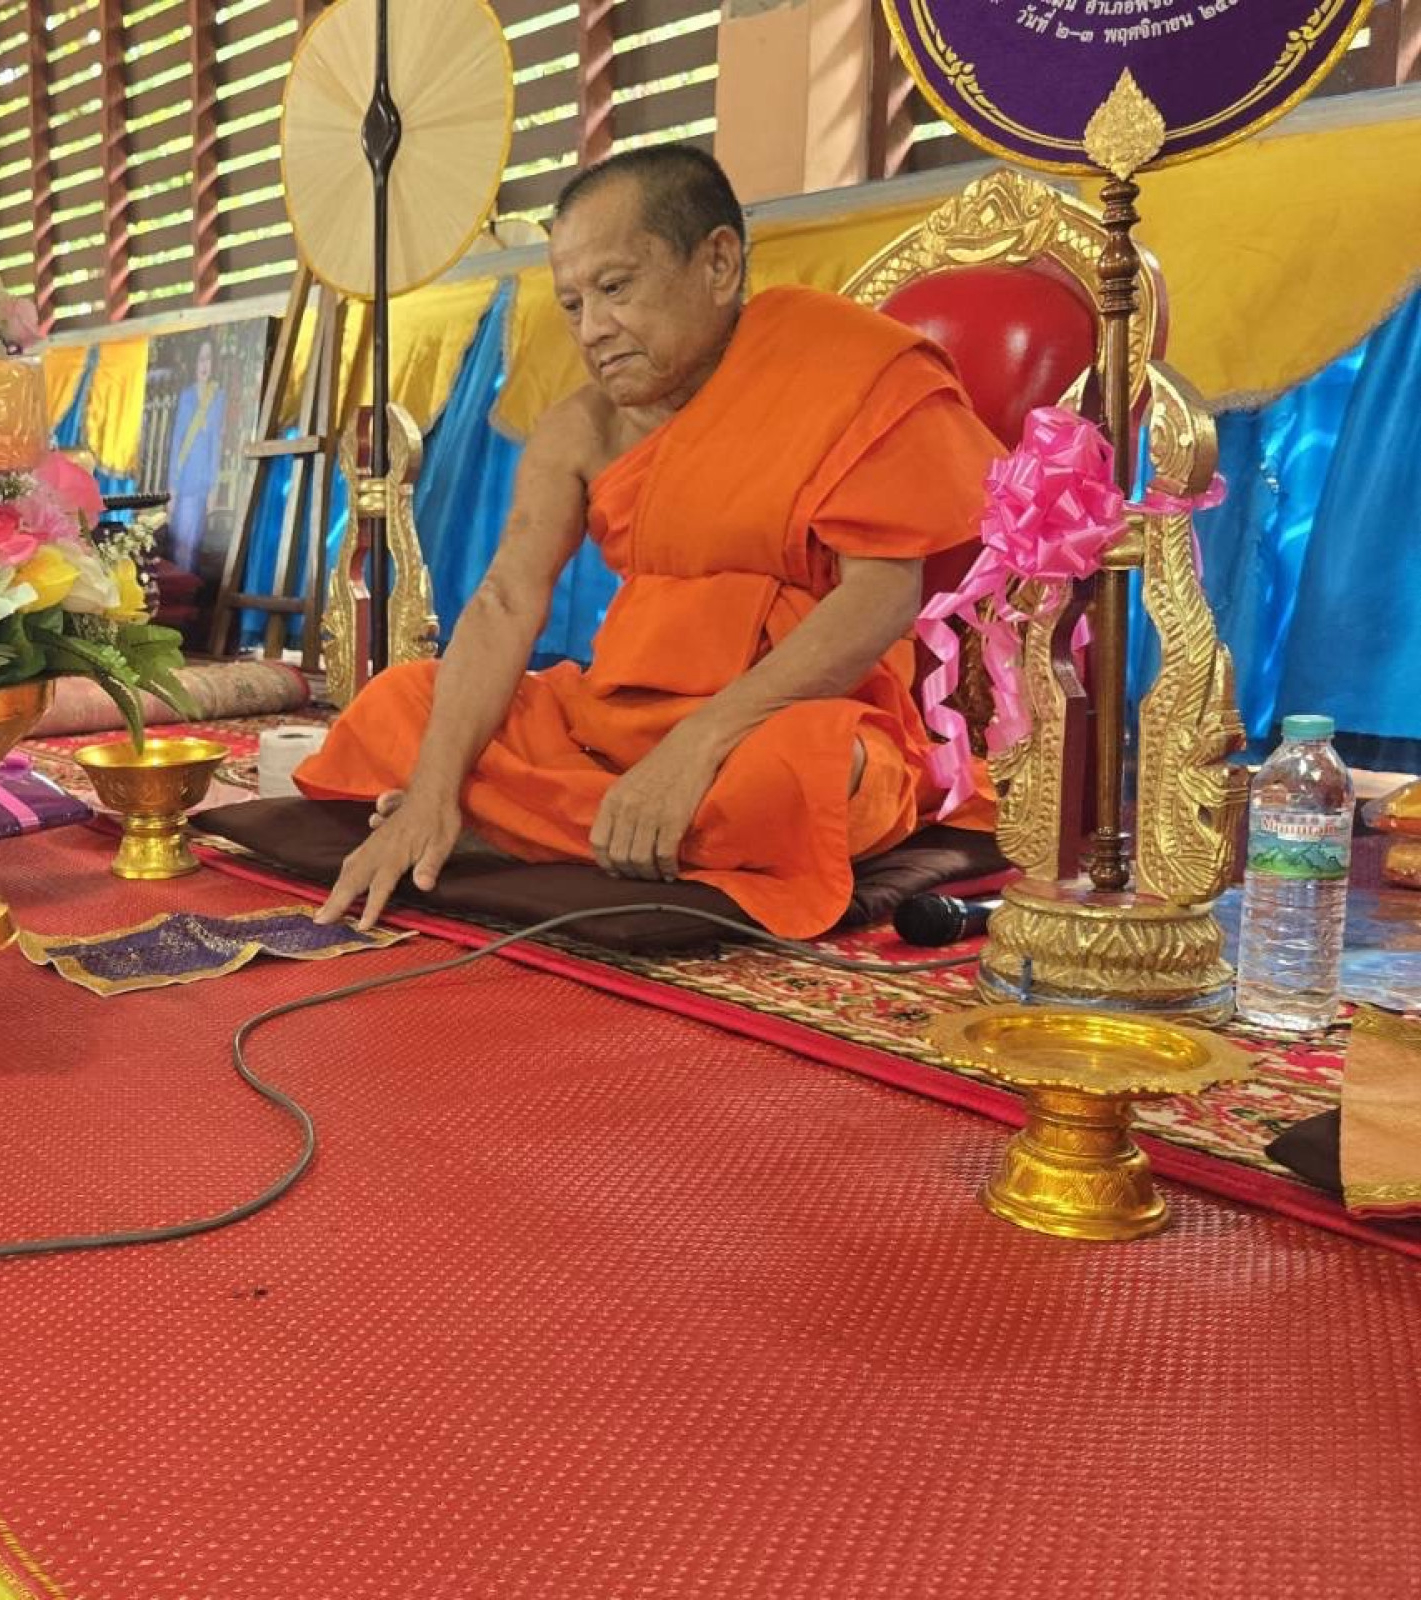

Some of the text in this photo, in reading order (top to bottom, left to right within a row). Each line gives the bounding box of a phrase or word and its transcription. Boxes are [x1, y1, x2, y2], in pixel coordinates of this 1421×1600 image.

[1016, 4, 1057, 34] วันที่
[1103, 12, 1195, 47] พฤศจิกายน
